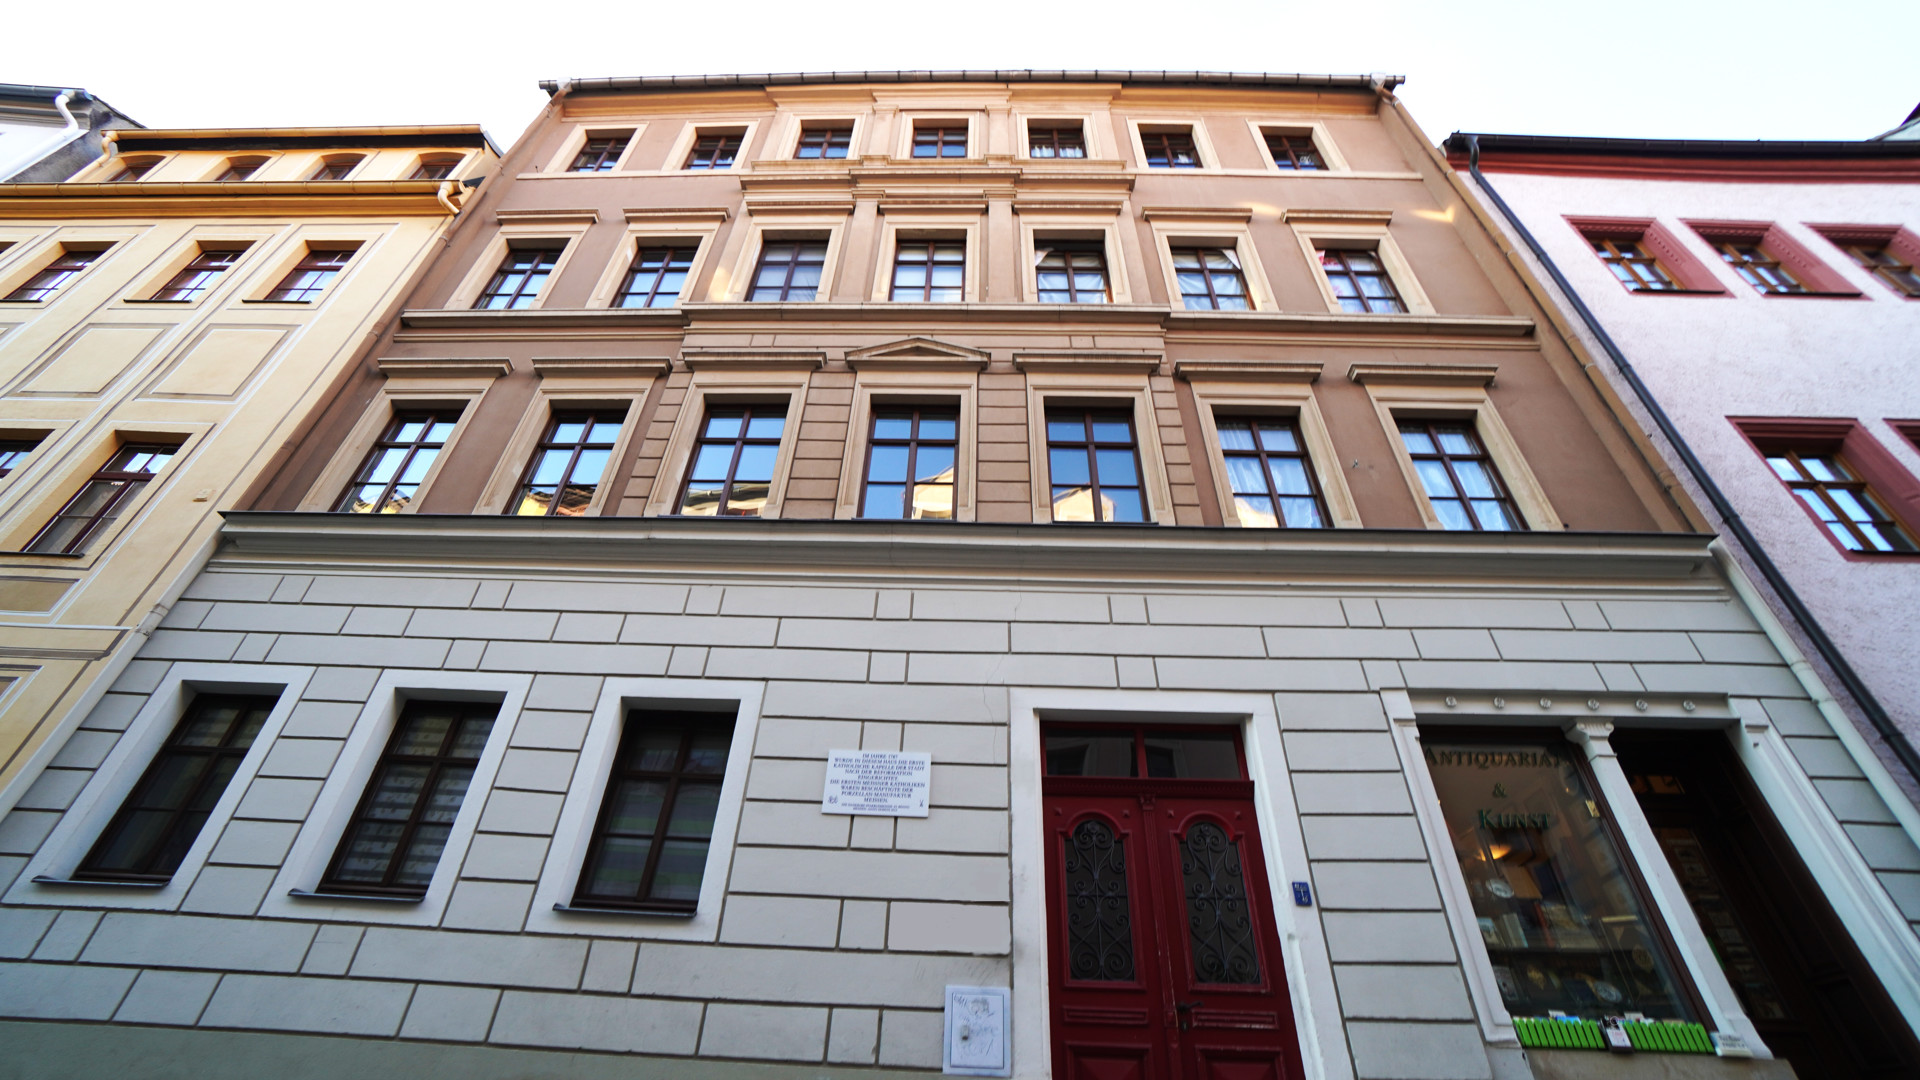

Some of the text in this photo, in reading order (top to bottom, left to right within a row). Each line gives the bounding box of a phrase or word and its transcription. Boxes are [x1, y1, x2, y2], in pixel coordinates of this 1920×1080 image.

[1422, 746, 1562, 770] ANTIQUARIAT
[1492, 782, 1508, 799] &
[1476, 808, 1550, 831] KUNST
